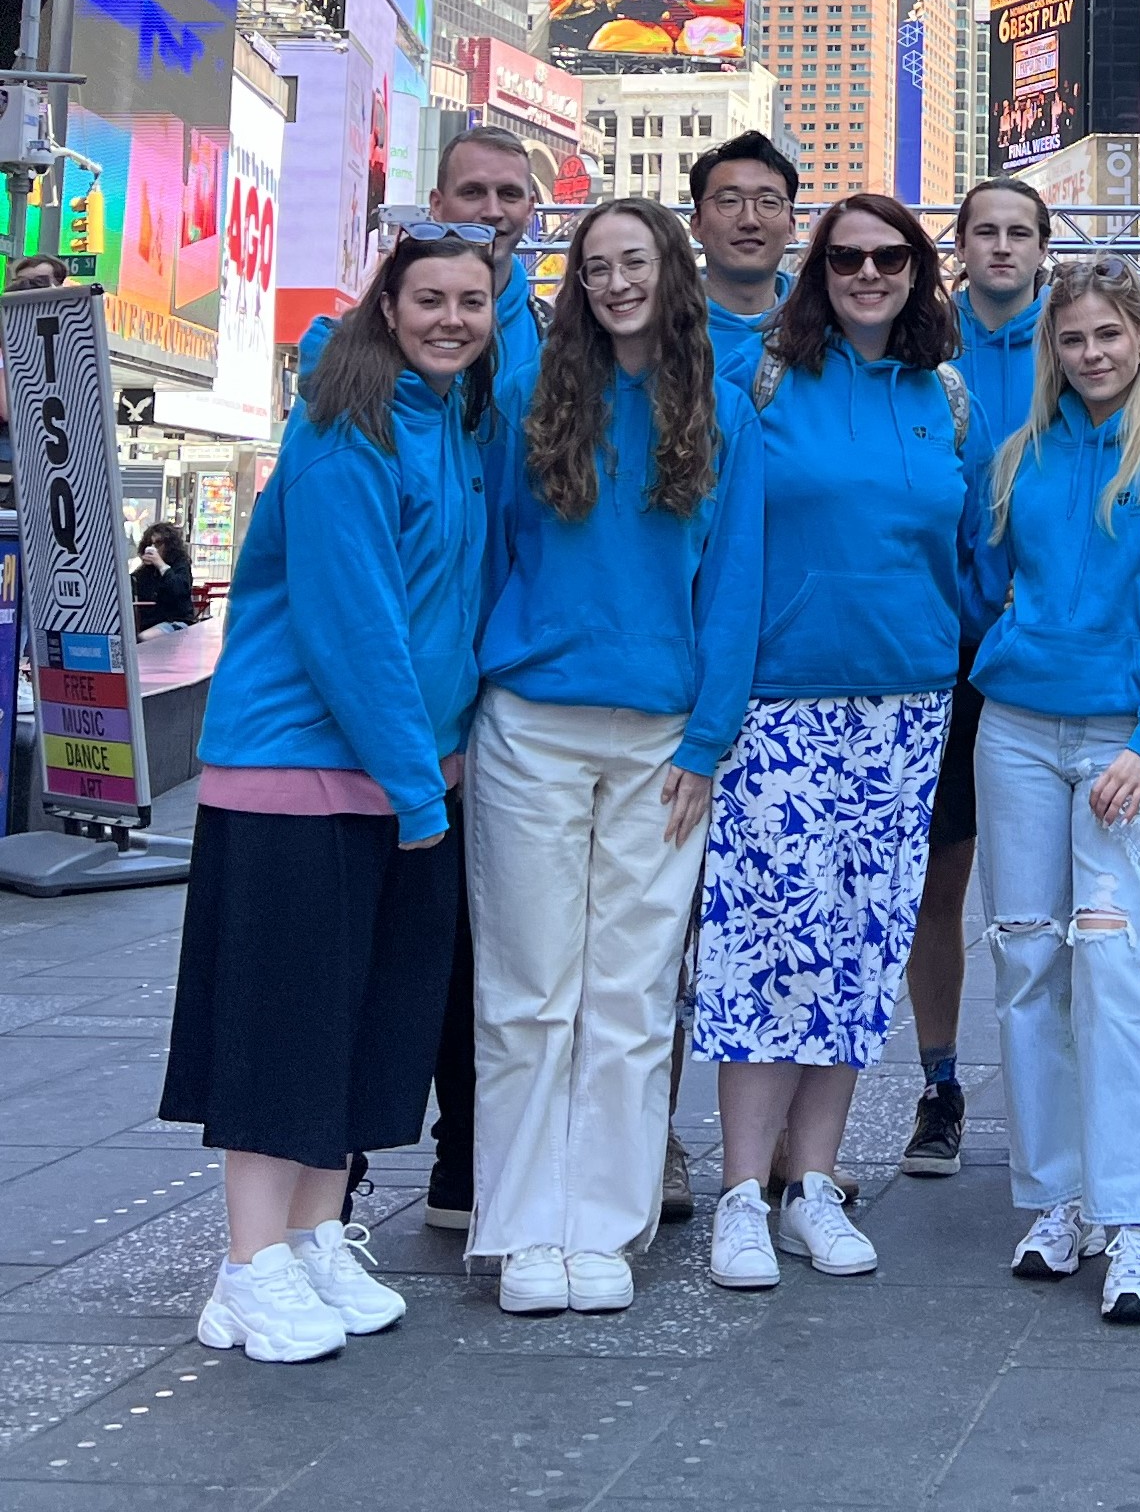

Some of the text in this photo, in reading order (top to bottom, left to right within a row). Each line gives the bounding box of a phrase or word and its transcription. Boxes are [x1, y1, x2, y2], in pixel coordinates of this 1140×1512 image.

[998, 9, 1010, 44] 6
[1010, 0, 1074, 40] BEST PLAY
[1008, 135, 1061, 159] FINAL WEEKS
[58, 578, 82, 598] LIVE
[63, 674, 97, 702] FREE
[61, 707, 105, 737] MUSIC
[65, 741, 110, 772] DANCE
[79, 776, 103, 800] ART
